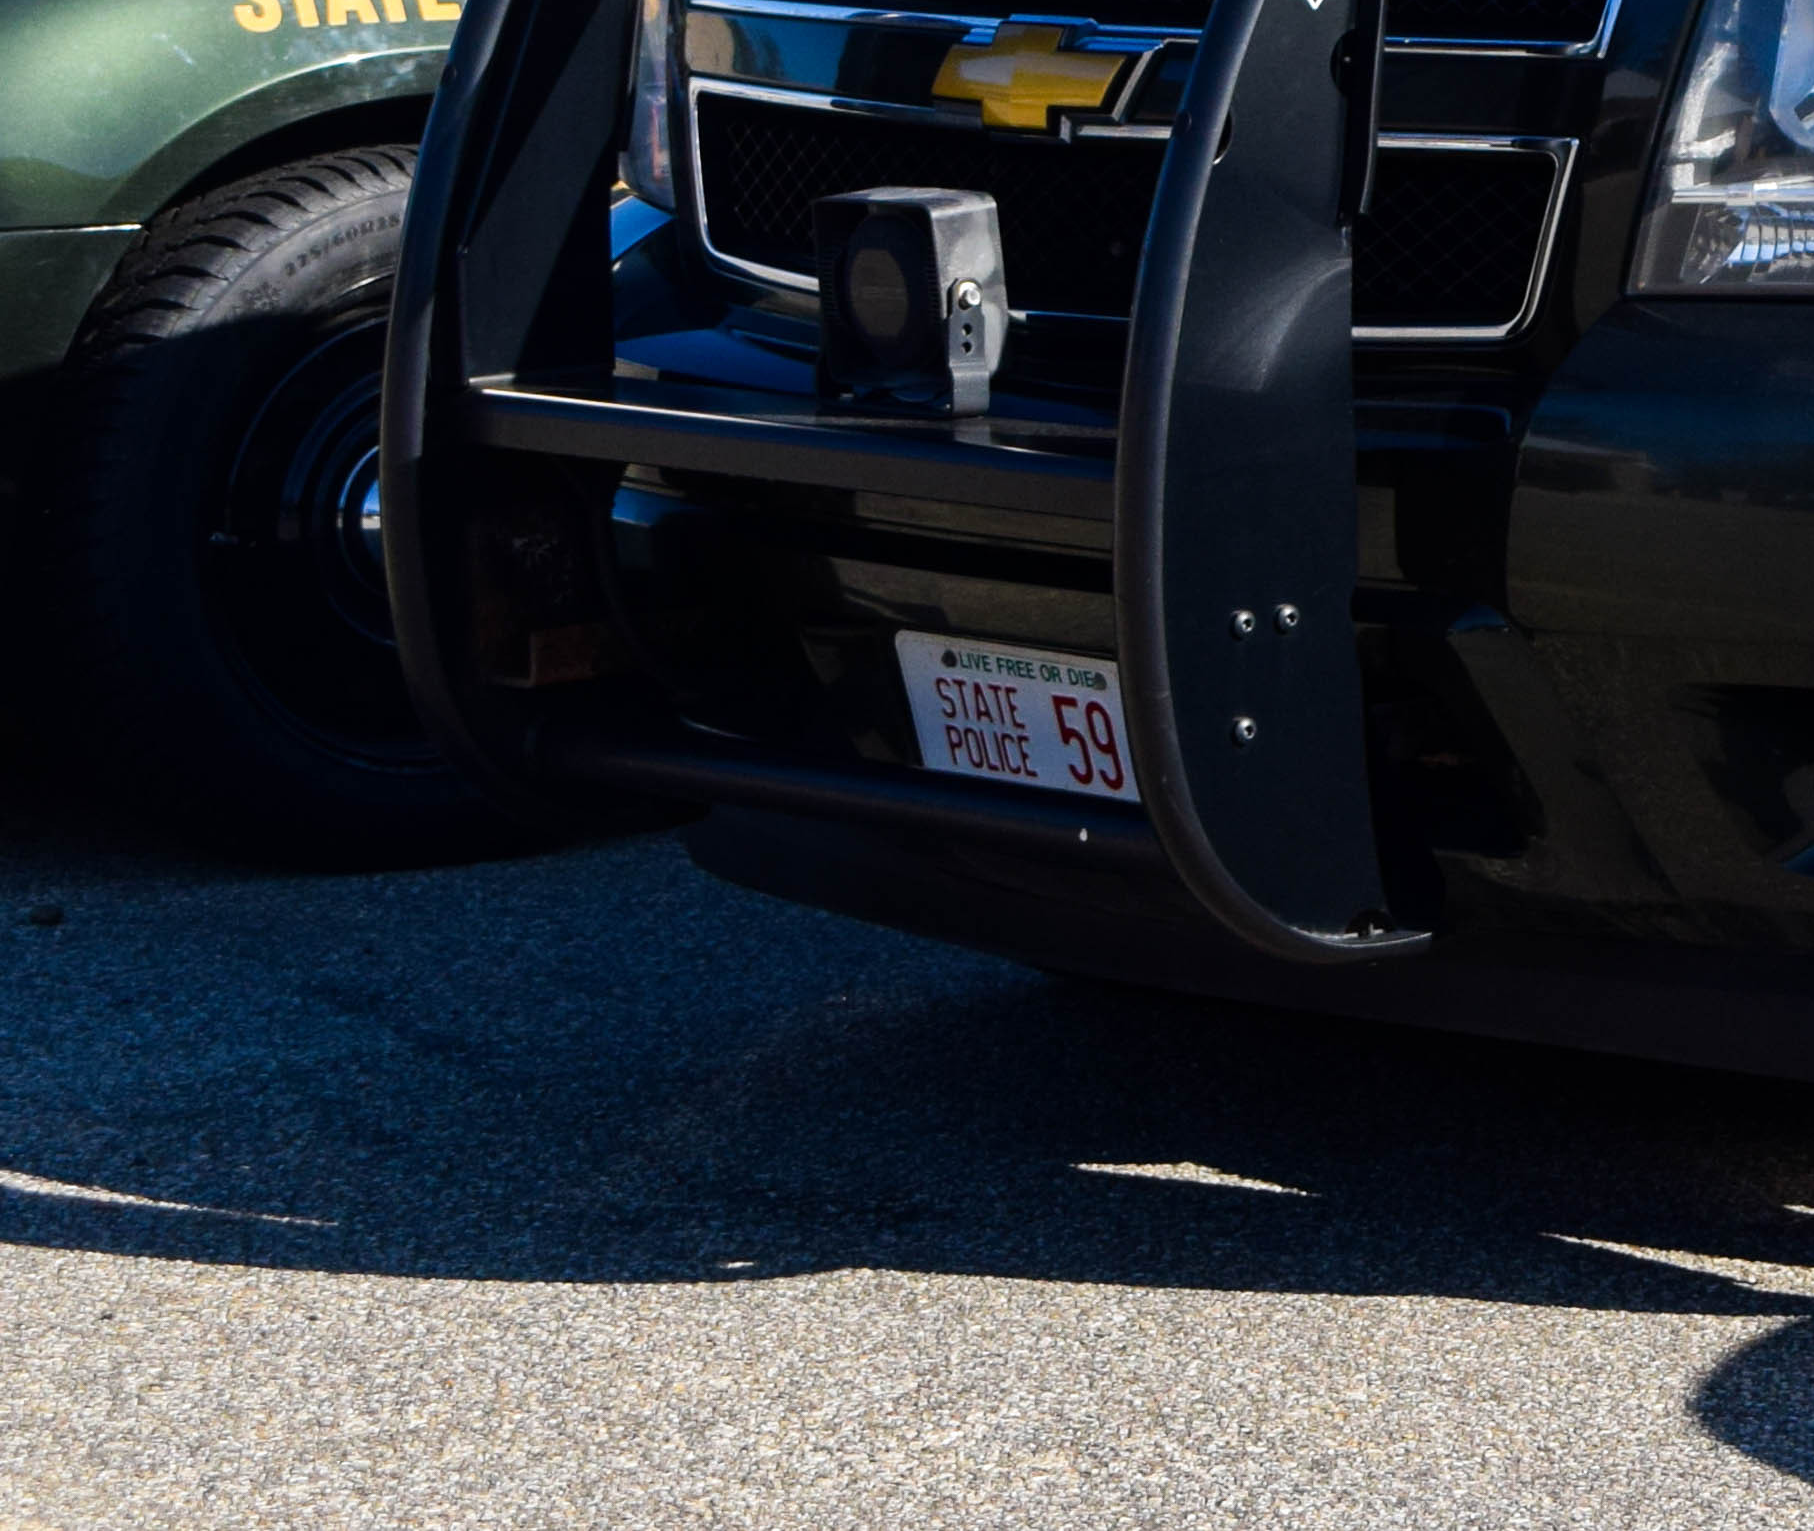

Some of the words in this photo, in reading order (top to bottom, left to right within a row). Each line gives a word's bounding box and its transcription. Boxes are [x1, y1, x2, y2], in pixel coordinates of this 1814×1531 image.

[958, 652, 992, 671] LIVE
[996, 657, 1035, 680] FREE
[1040, 664, 1063, 682] OR
[1068, 669, 1094, 687] DIE
[935, 677, 1025, 730] STATE
[945, 724, 1038, 777] POLICE
[1051, 694, 1124, 790] 59
